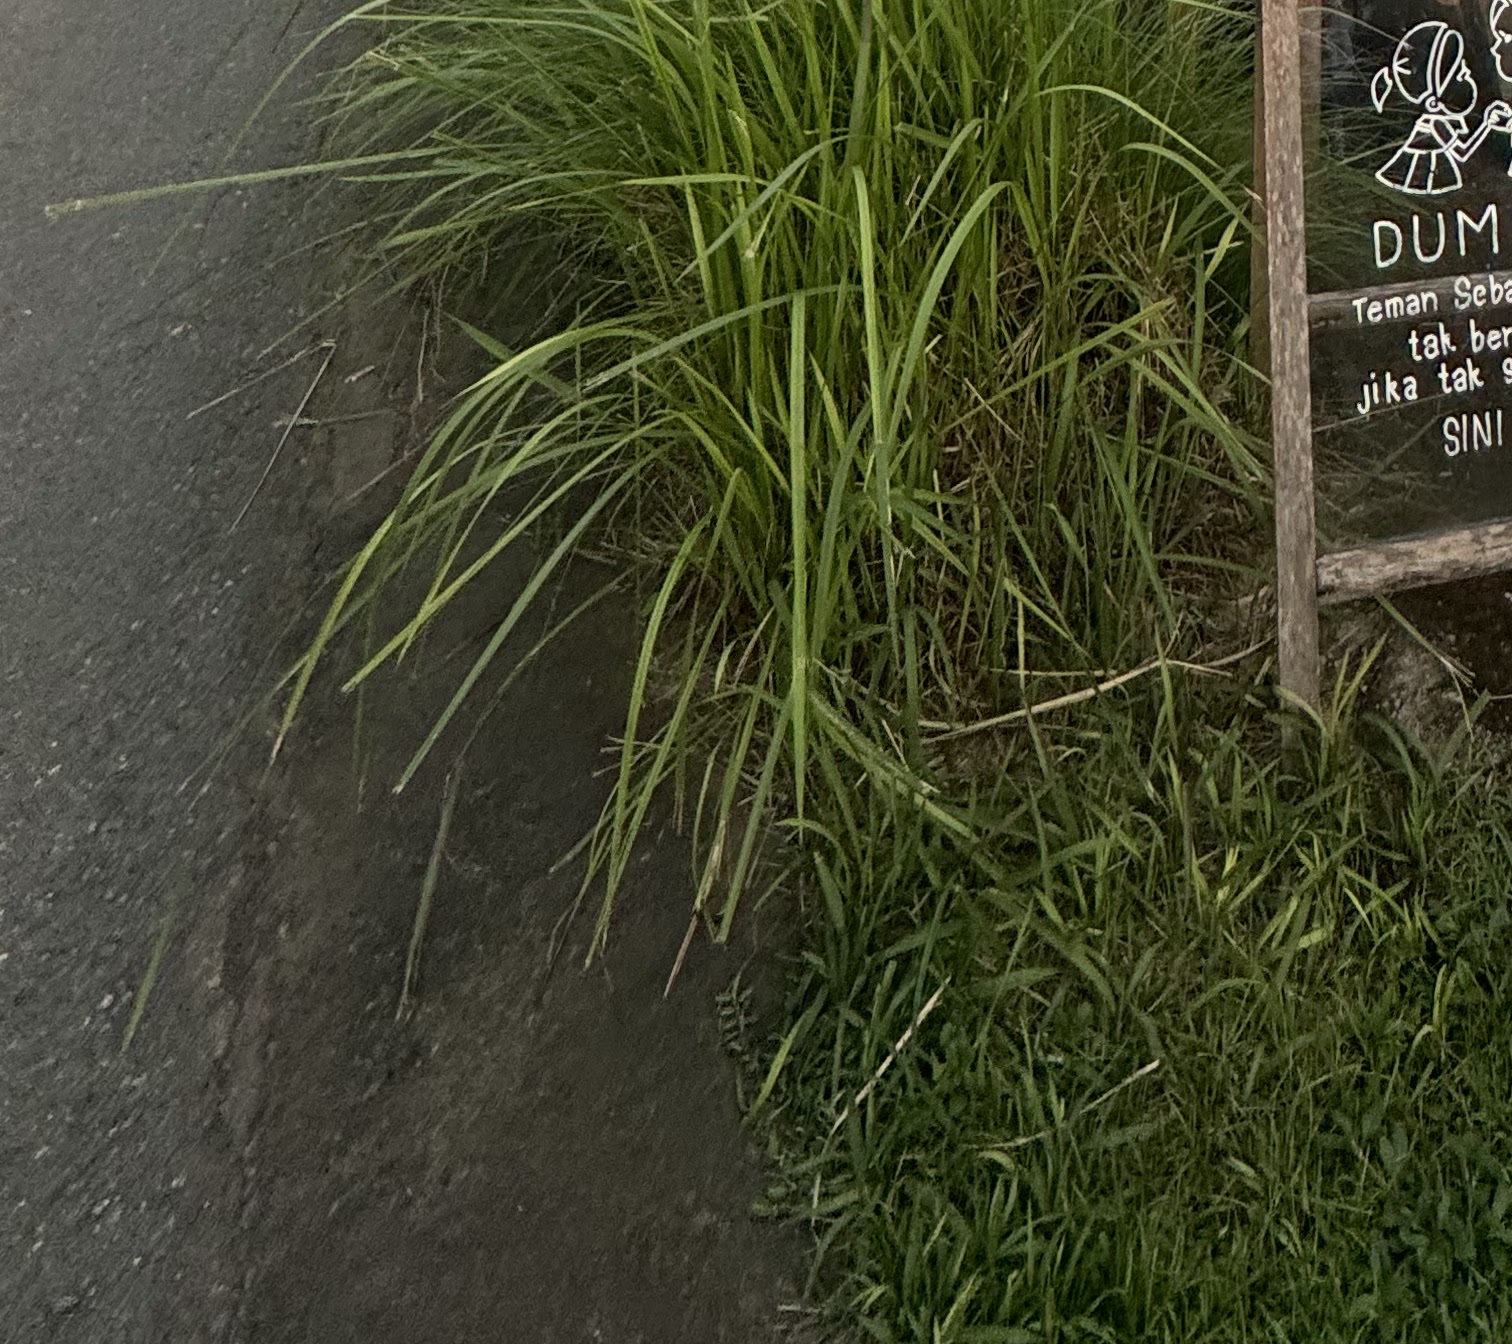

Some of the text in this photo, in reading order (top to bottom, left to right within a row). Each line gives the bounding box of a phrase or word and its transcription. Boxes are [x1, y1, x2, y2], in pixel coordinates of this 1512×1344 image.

[1351, 290, 1438, 324] Teman
[1408, 321, 1457, 362] tak
[1355, 370, 1419, 415] jika
[1437, 358, 1485, 394] tak
[1442, 409, 1503, 457] SINI
